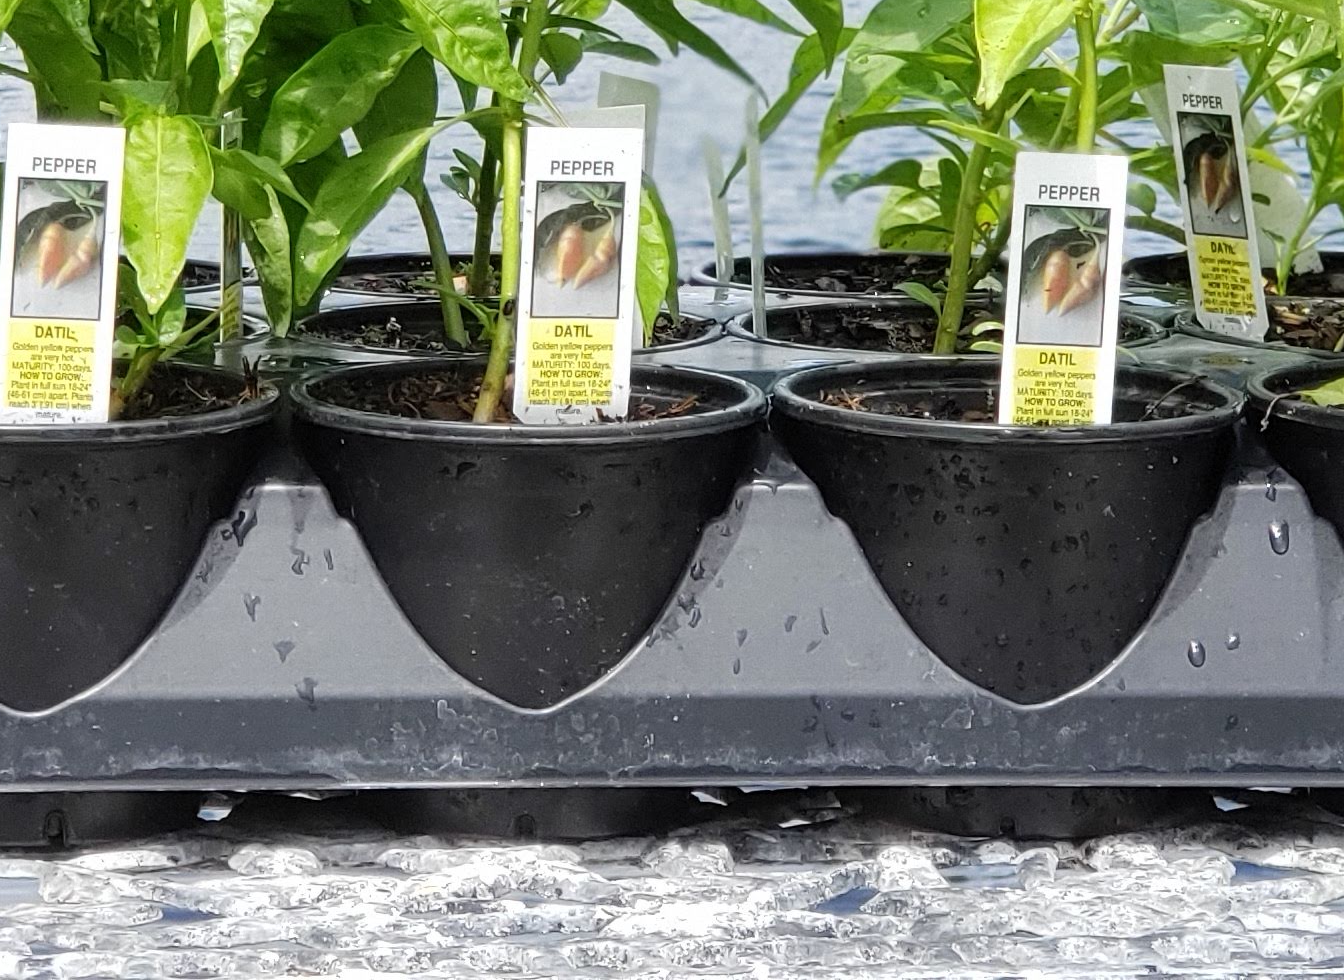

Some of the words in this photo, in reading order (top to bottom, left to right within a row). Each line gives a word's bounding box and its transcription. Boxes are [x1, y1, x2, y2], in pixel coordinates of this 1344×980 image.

[1182, 94, 1222, 109] PEPPER
[32, 157, 96, 174] PEPPER
[551, 161, 614, 176] PEPPER
[1038, 185, 1100, 202] PEPPER
[35, 326, 76, 339] DATIL
[555, 325, 593, 337] DATIL
[578, 361, 590, 369] 100
[1040, 352, 1077, 365] DATIL
[20, 372, 40, 380] HOW
[42, 372, 53, 380] TO
[1048, 381, 1062, 389] very
[1025, 398, 1043, 406] HOW
[1046, 398, 1056, 406] TO
